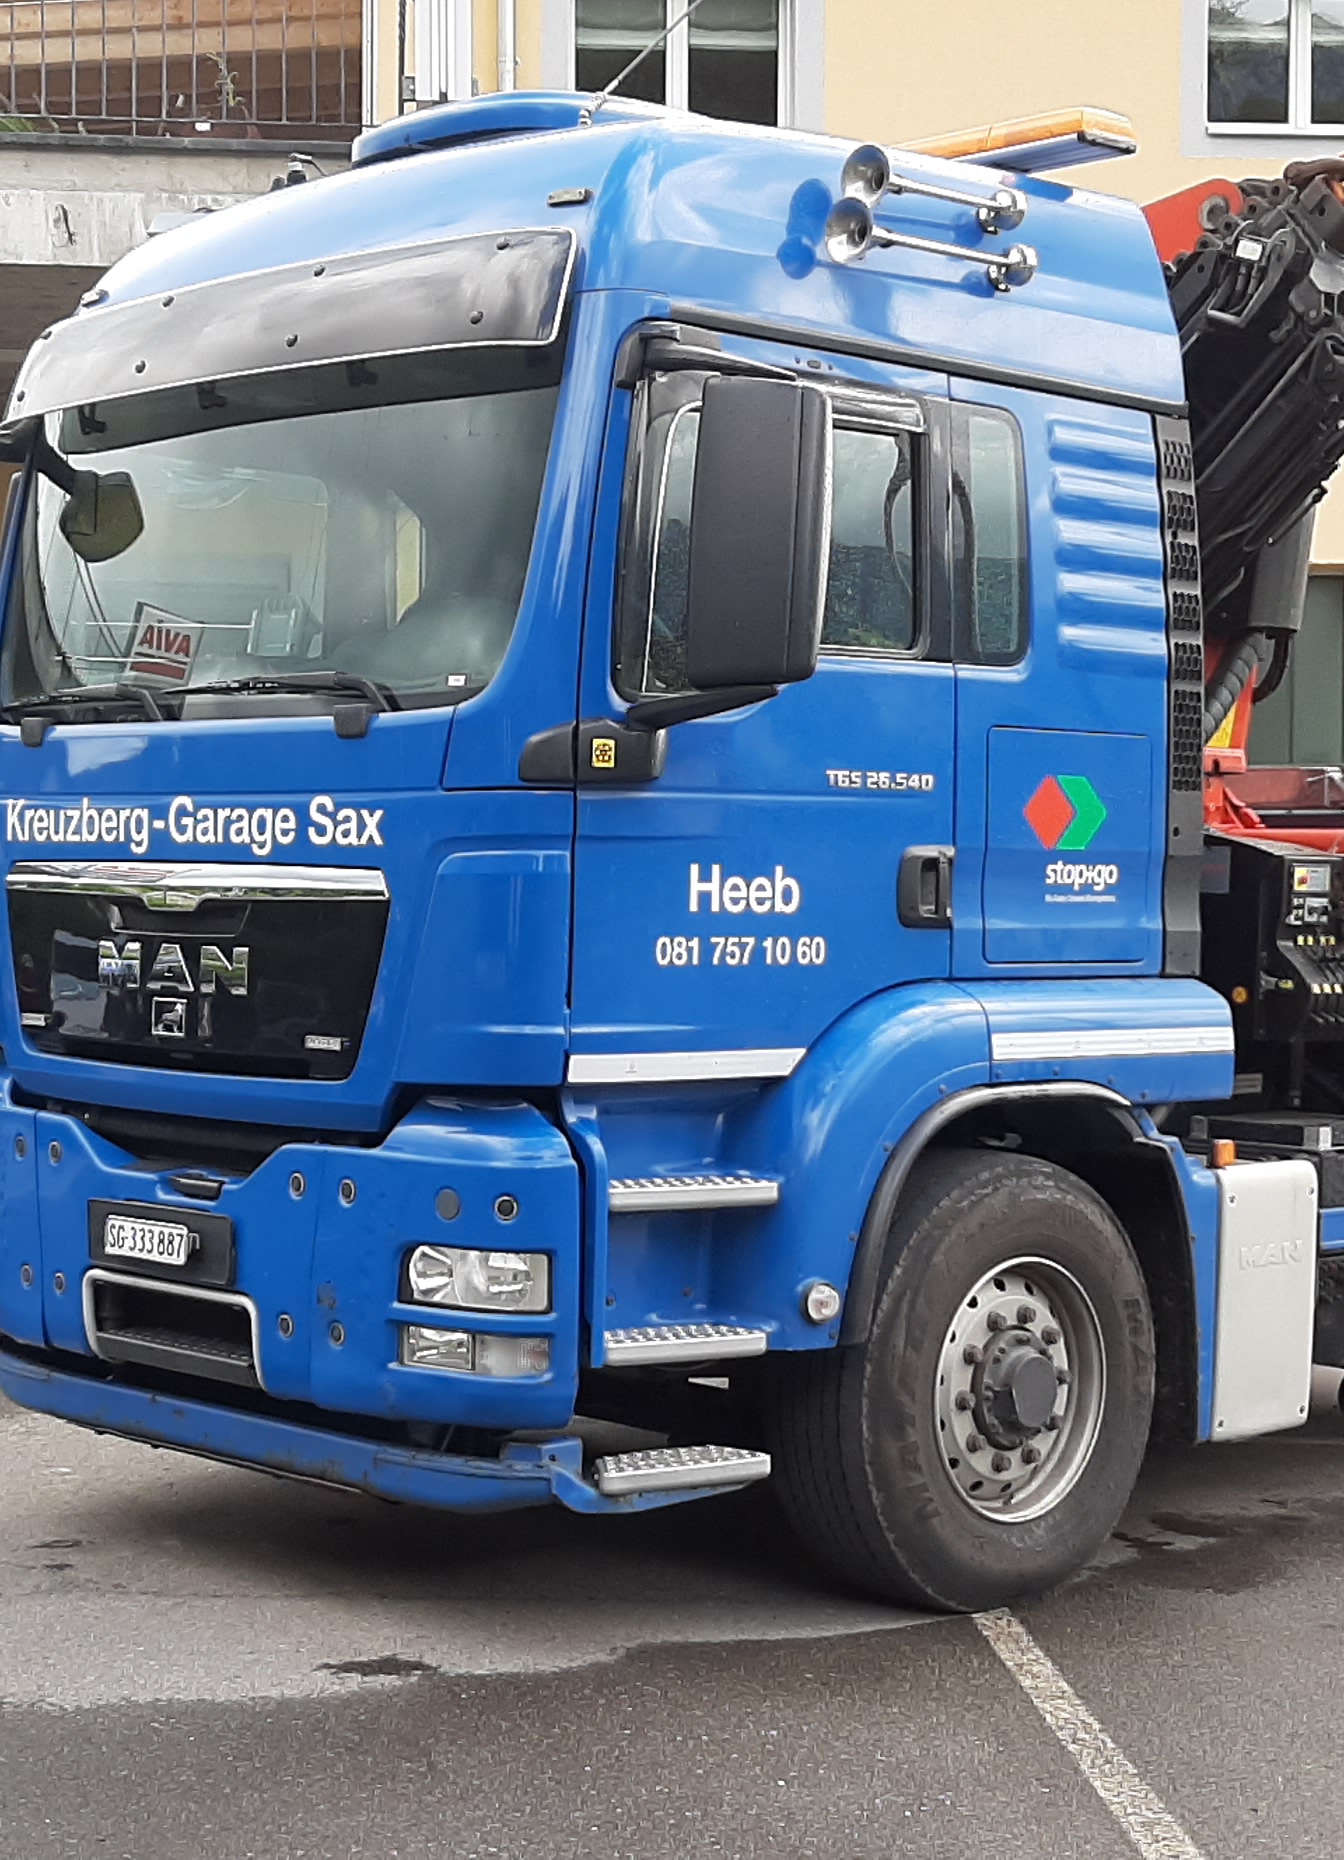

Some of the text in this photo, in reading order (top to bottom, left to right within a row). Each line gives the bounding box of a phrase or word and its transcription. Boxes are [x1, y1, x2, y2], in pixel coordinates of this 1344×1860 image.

[865, 772, 935, 792] 26.540
[5, 795, 385, 856] Kreuzberg-Garage Sax
[688, 863, 801, 914] Heeb
[98, 940, 251, 996] MAN
[655, 936, 826, 966] 081 757 10 60
